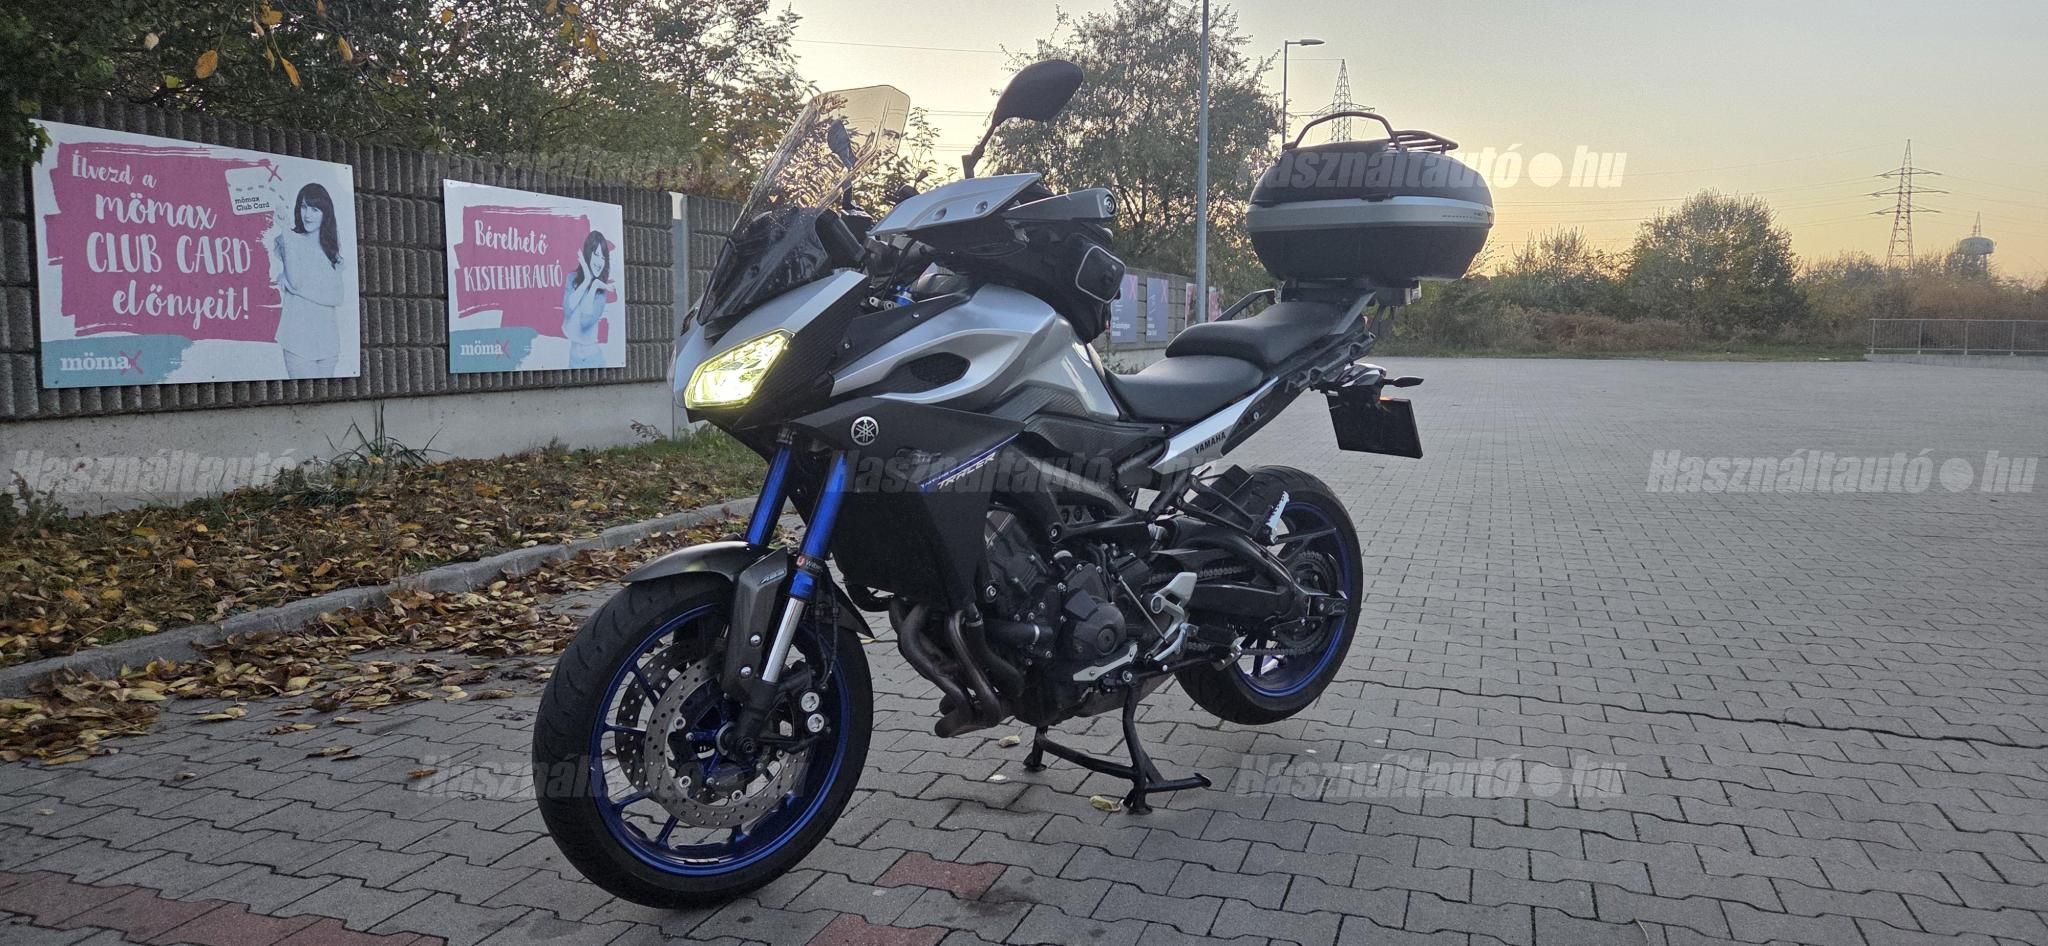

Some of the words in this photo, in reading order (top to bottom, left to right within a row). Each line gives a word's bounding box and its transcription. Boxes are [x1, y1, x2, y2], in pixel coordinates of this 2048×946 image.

[72, 150, 134, 187] Élvezd
[142, 172, 157, 189] a
[96, 192, 217, 231] mömax
[236, 203, 253, 212] Club
[253, 201, 271, 210] Card
[86, 231, 163, 274] CLUB
[176, 234, 251, 275] CARD
[475, 219, 549, 256] Bérelhető
[464, 259, 563, 292] KISTEHERAUTÓ
[1194, 431, 1227, 455] YAMAHA
[937, 451, 997, 490] TRACER
